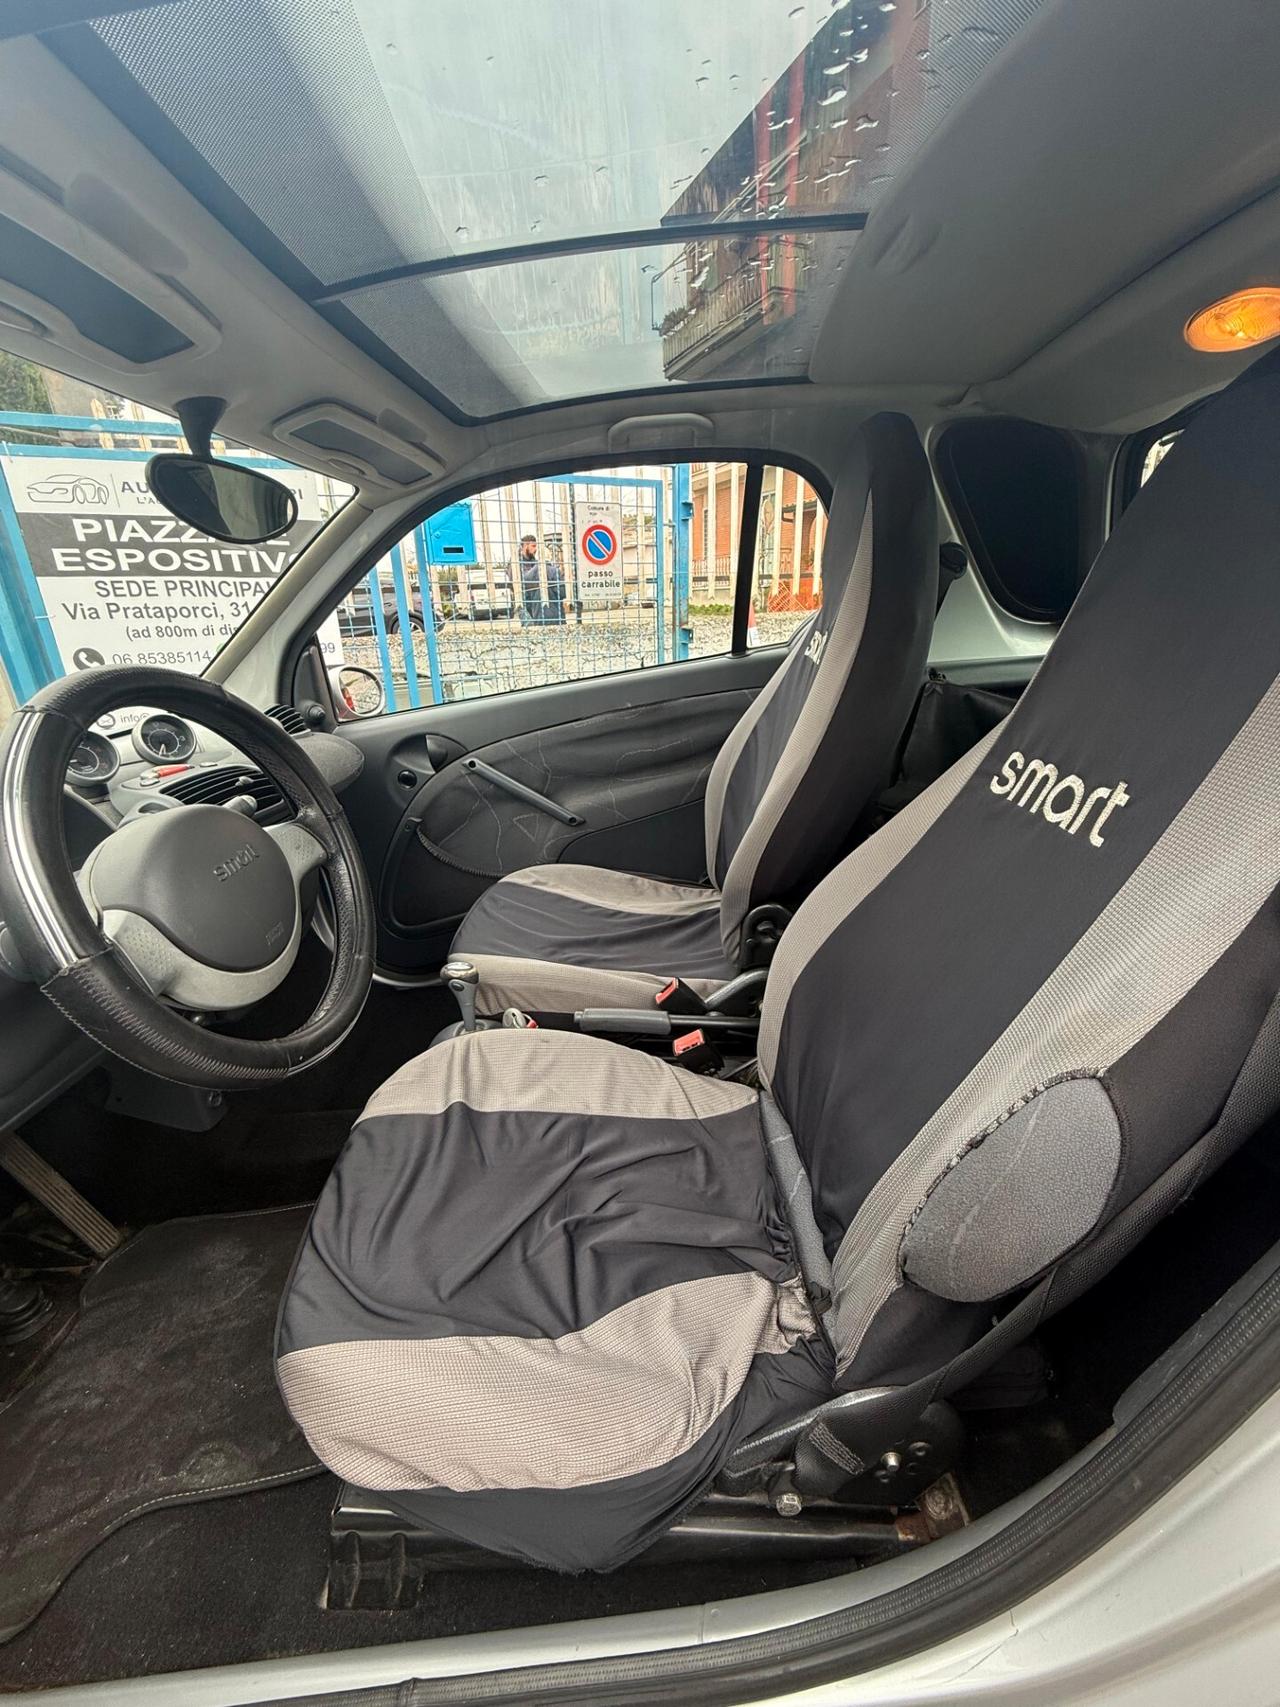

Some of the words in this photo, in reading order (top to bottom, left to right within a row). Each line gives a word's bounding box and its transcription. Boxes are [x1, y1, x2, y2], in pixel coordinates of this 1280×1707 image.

[588, 570, 613, 578] passo
[95, 580, 159, 598] SEDE
[581, 580, 620, 588] carrabile
[62, 602, 101, 620] Via
[106, 601, 225, 622] Prataporci,
[126, 627, 151, 642] (ad
[156, 625, 197, 638] 800m
[201, 624, 215, 637] di
[112, 653, 133, 665] 06
[138, 650, 212, 665] 85385114
[989, 751, 1131, 848] smart
